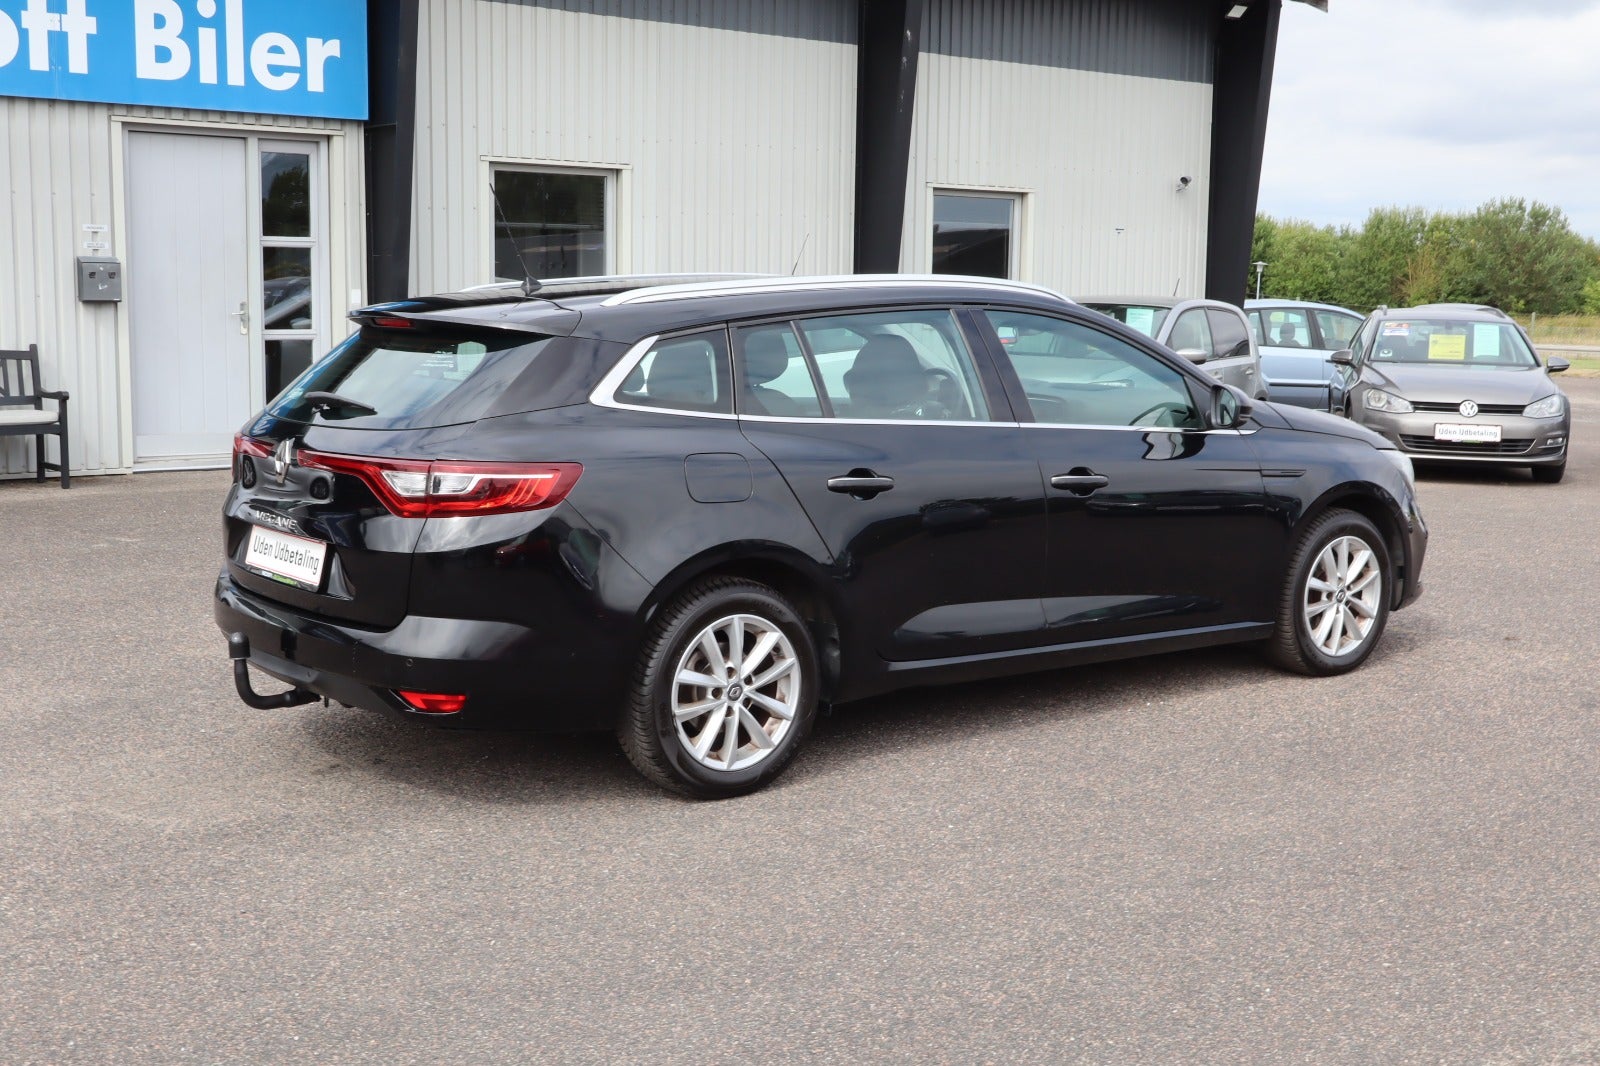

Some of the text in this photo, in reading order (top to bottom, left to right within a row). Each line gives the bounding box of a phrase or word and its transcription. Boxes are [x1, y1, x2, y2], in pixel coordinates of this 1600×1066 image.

[134, 0, 341, 93] Biler
[1438, 428, 1498, 439] Uden Udbetaling
[256, 510, 297, 530] MEGANE
[253, 535, 320, 576] Uden Udbetaling
